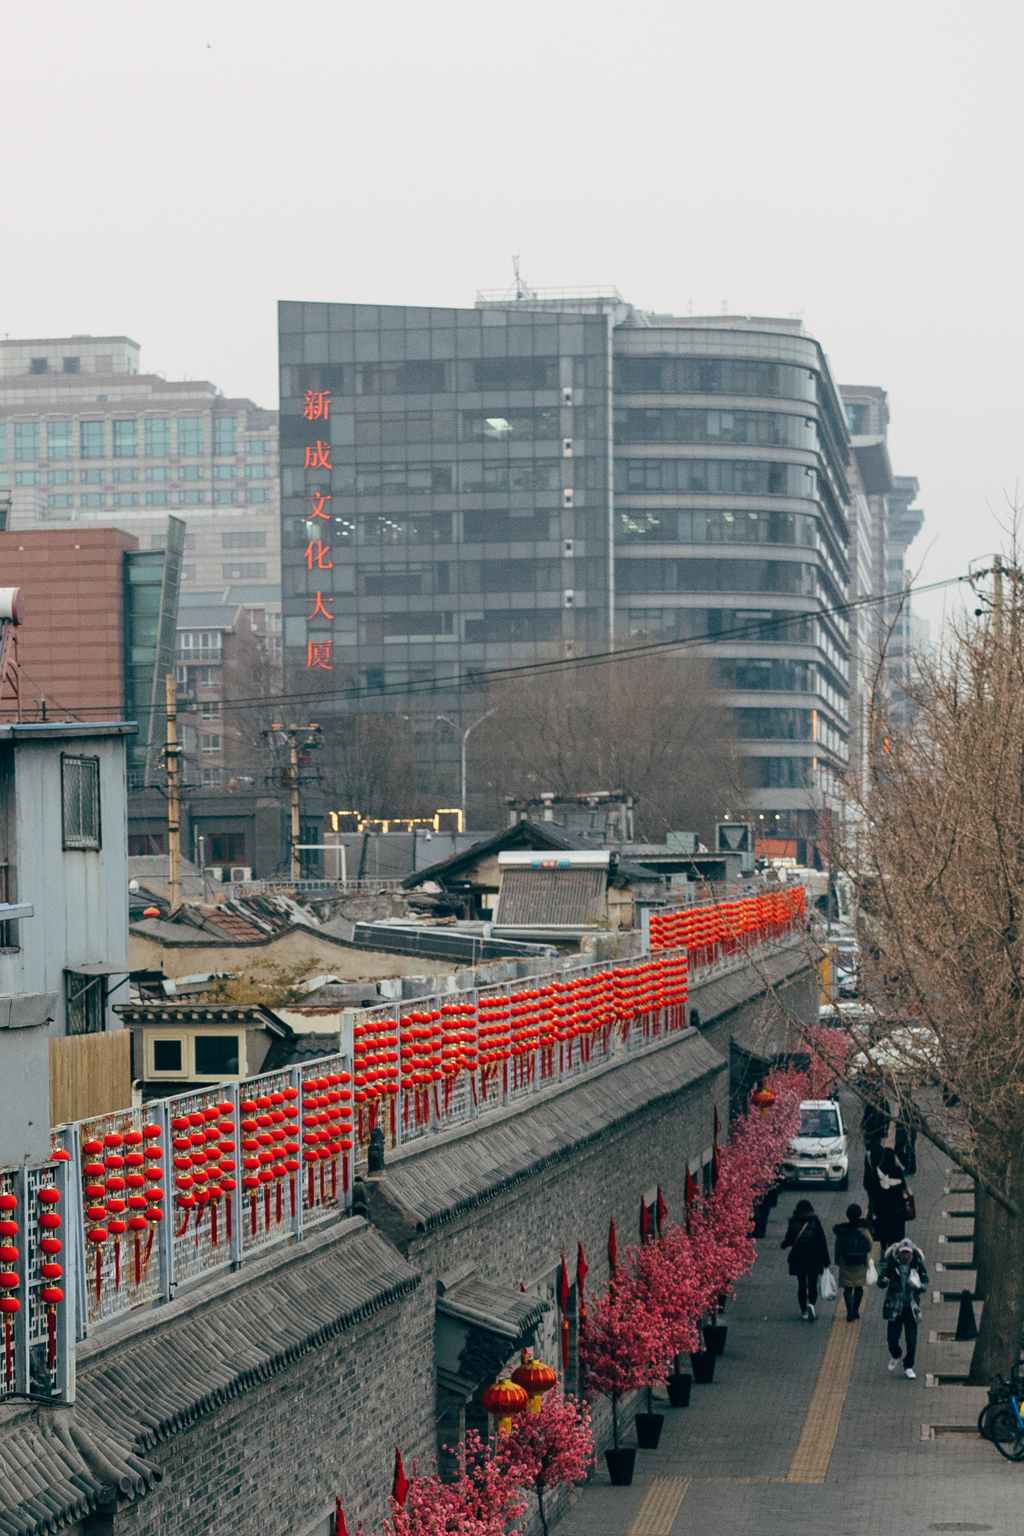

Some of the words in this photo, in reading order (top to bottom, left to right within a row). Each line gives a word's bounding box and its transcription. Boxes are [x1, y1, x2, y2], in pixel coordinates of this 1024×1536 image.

[303, 390, 333, 669] 新成文化大厦
